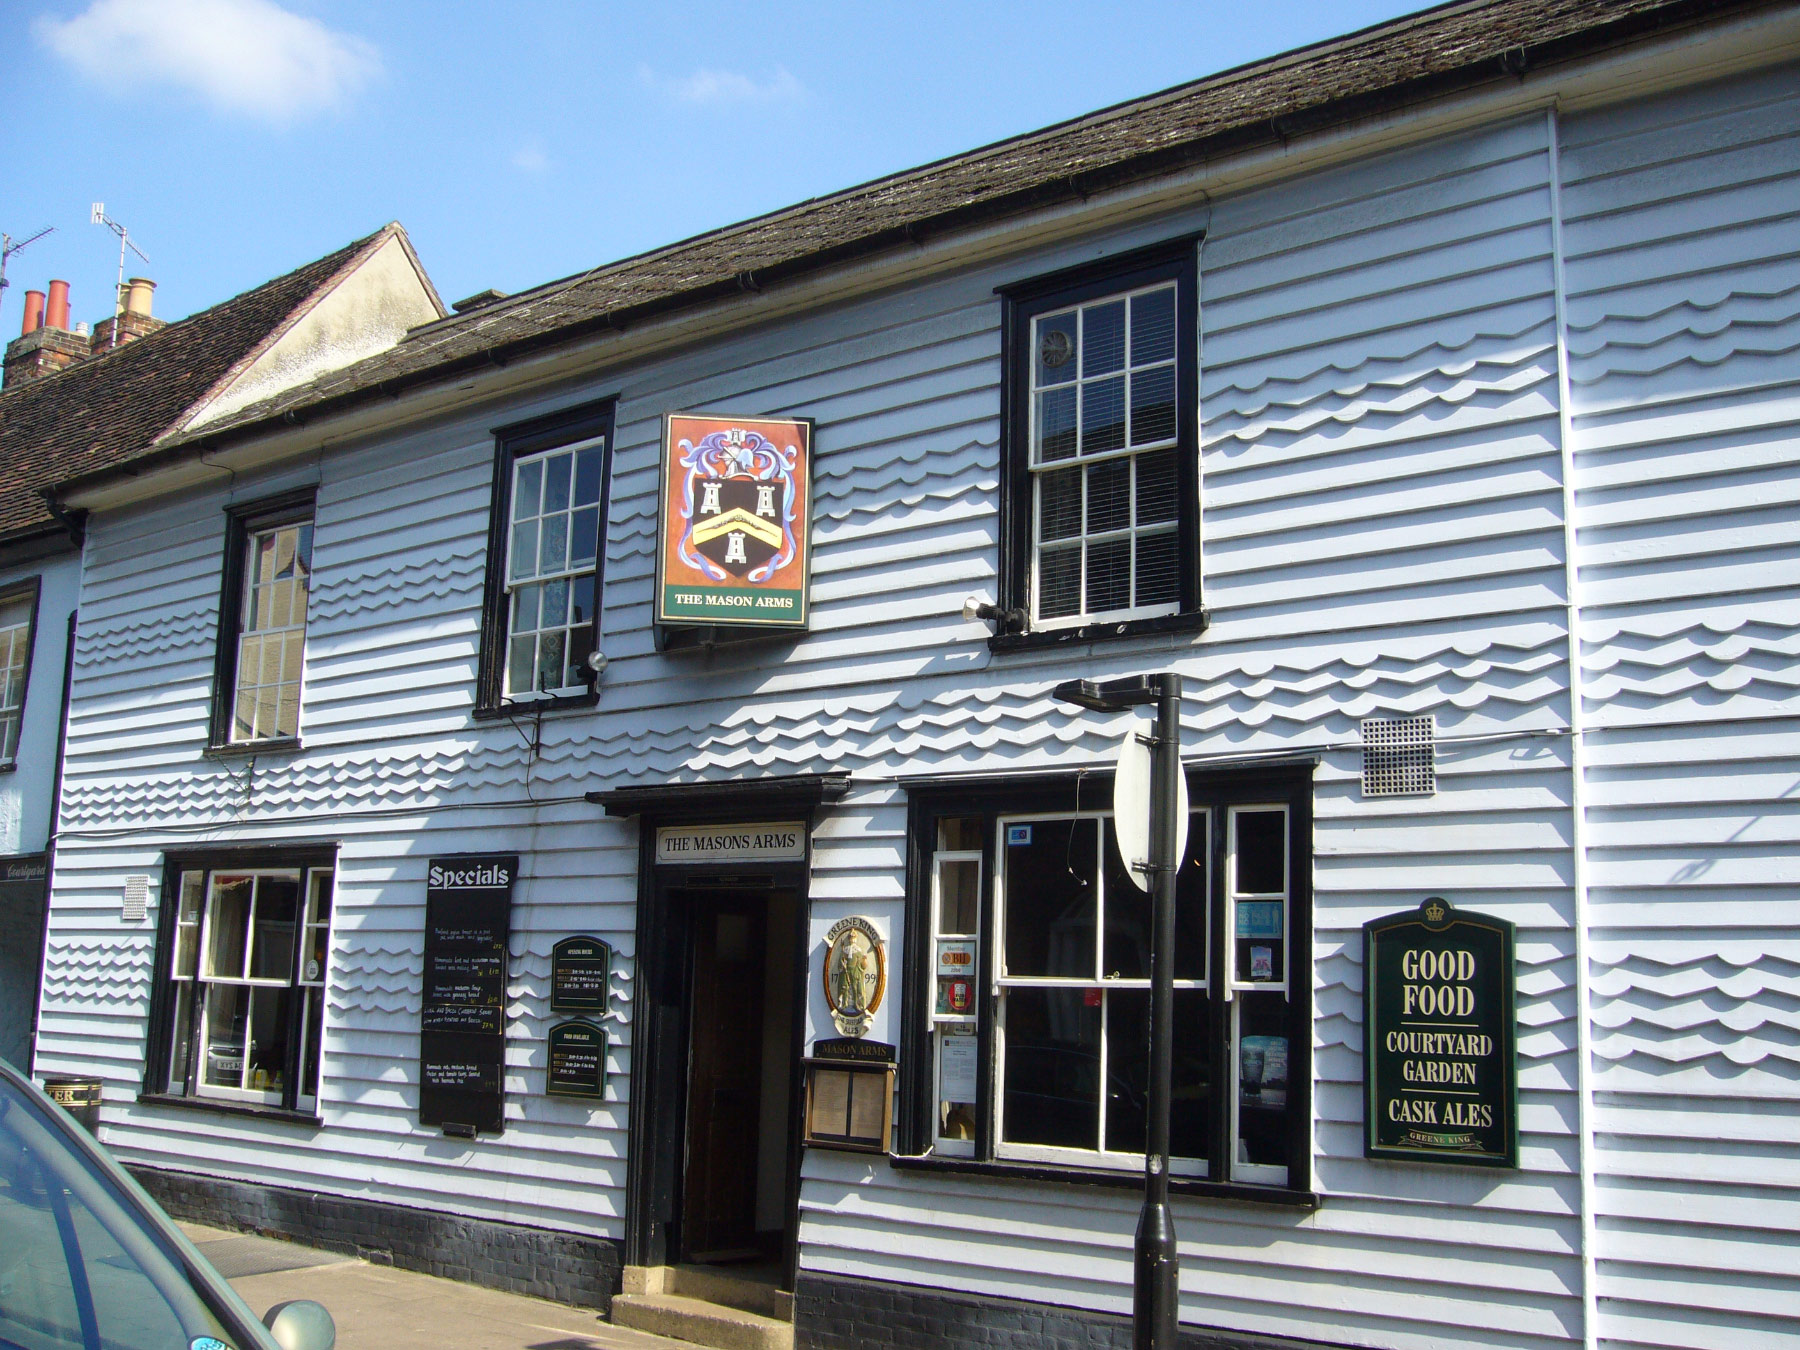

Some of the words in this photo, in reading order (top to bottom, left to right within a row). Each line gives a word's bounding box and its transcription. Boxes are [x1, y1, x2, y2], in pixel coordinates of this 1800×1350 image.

[675, 594, 702, 604] THE
[705, 595, 752, 606] MASON
[756, 597, 794, 608] ARMS
[665, 837, 690, 851] THE
[693, 835, 750, 851] MASONS
[753, 833, 796, 849] ARMS
[7, 863, 46, 880] Courtyard
[428, 864, 509, 890] Specials
[827, 917, 858, 941] GREENE
[859, 918, 878, 940] KING
[1402, 949, 1476, 982] GOOD
[831, 973, 838, 984] 17
[864, 973, 876, 984] 99
[1402, 984, 1476, 1016] FOOD
[843, 1026, 859, 1034] ALES
[822, 1044, 856, 1054] MASON
[858, 1045, 887, 1056] ARMS
[1386, 1031, 1493, 1057] COURTYARD
[1402, 1060, 1477, 1086] GARDEN
[1388, 1099, 1439, 1124] CASK
[1442, 1102, 1493, 1128] ALES
[1409, 1132, 1446, 1144] GREENE
[1448, 1135, 1470, 1143] KING
